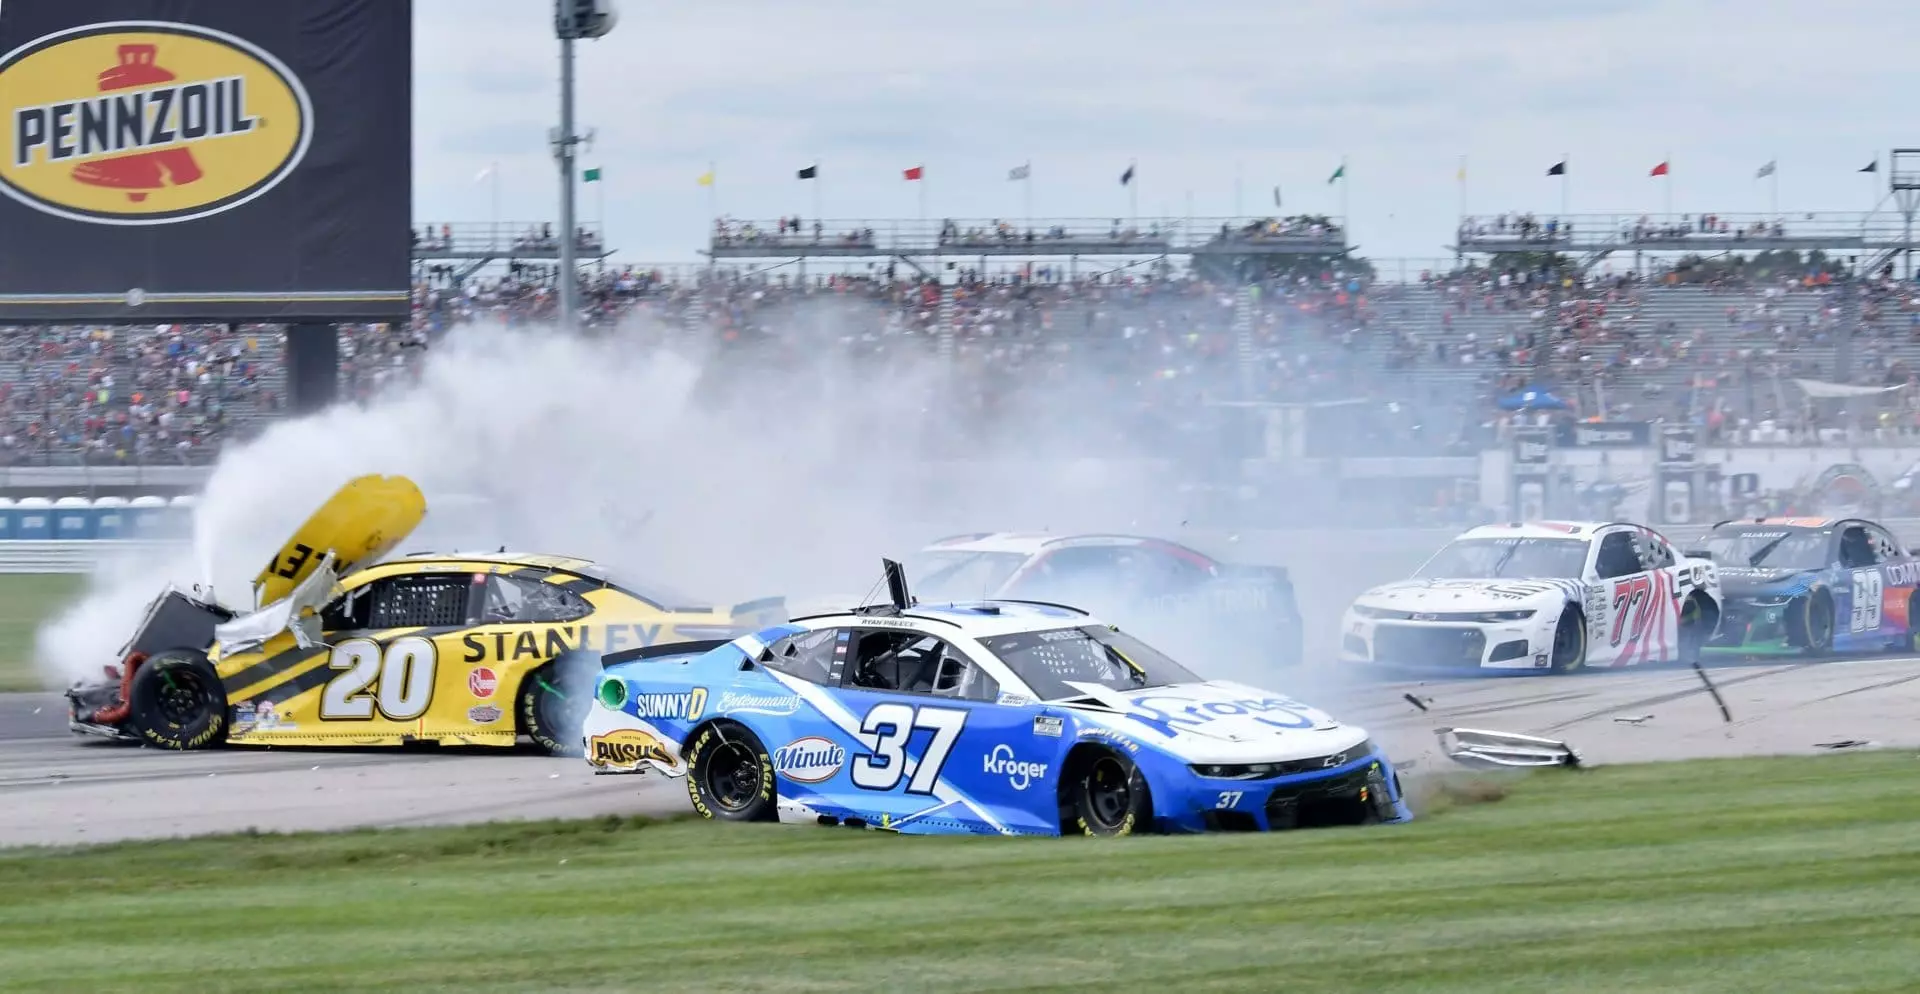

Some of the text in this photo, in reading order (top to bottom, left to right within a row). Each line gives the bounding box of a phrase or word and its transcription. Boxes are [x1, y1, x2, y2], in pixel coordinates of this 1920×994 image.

[15, 75, 255, 167] PENNZOIL
[1609, 573, 1651, 649] 77
[318, 635, 440, 723] 20
[759, 752, 772, 802] EAGLE
[774, 743, 845, 772] Minute
[850, 702, 972, 796] 37
[983, 743, 1048, 790] Kroger
[1215, 791, 1244, 809] 37
